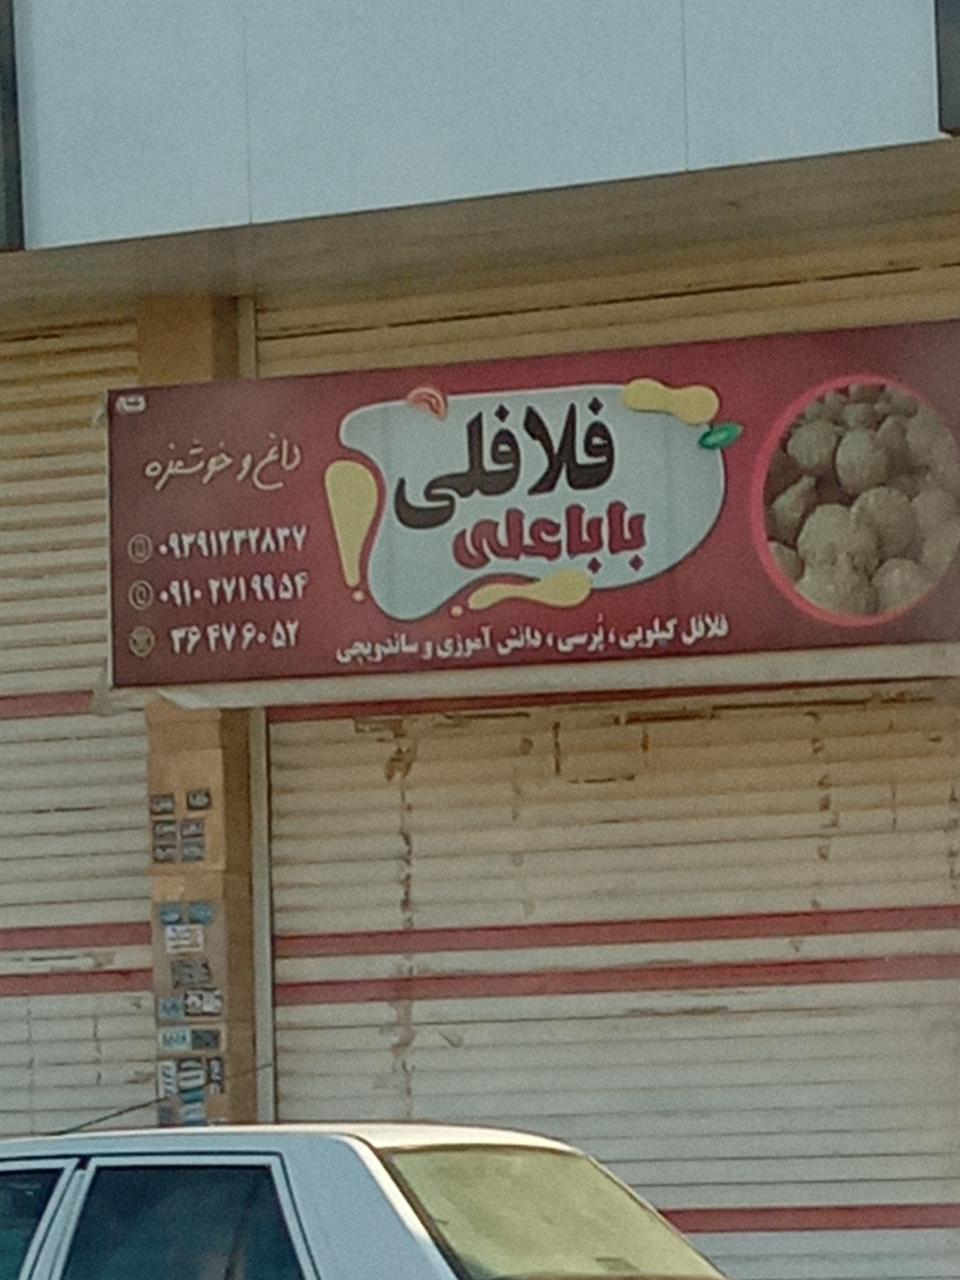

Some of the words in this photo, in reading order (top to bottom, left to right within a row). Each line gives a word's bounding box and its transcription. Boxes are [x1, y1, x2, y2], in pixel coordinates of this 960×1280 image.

[236, 453, 253, 482] و
[394, 398, 614, 529] فلافلی
[496, 625, 542, 655] دانش
[681, 613, 729, 645] فلافل
